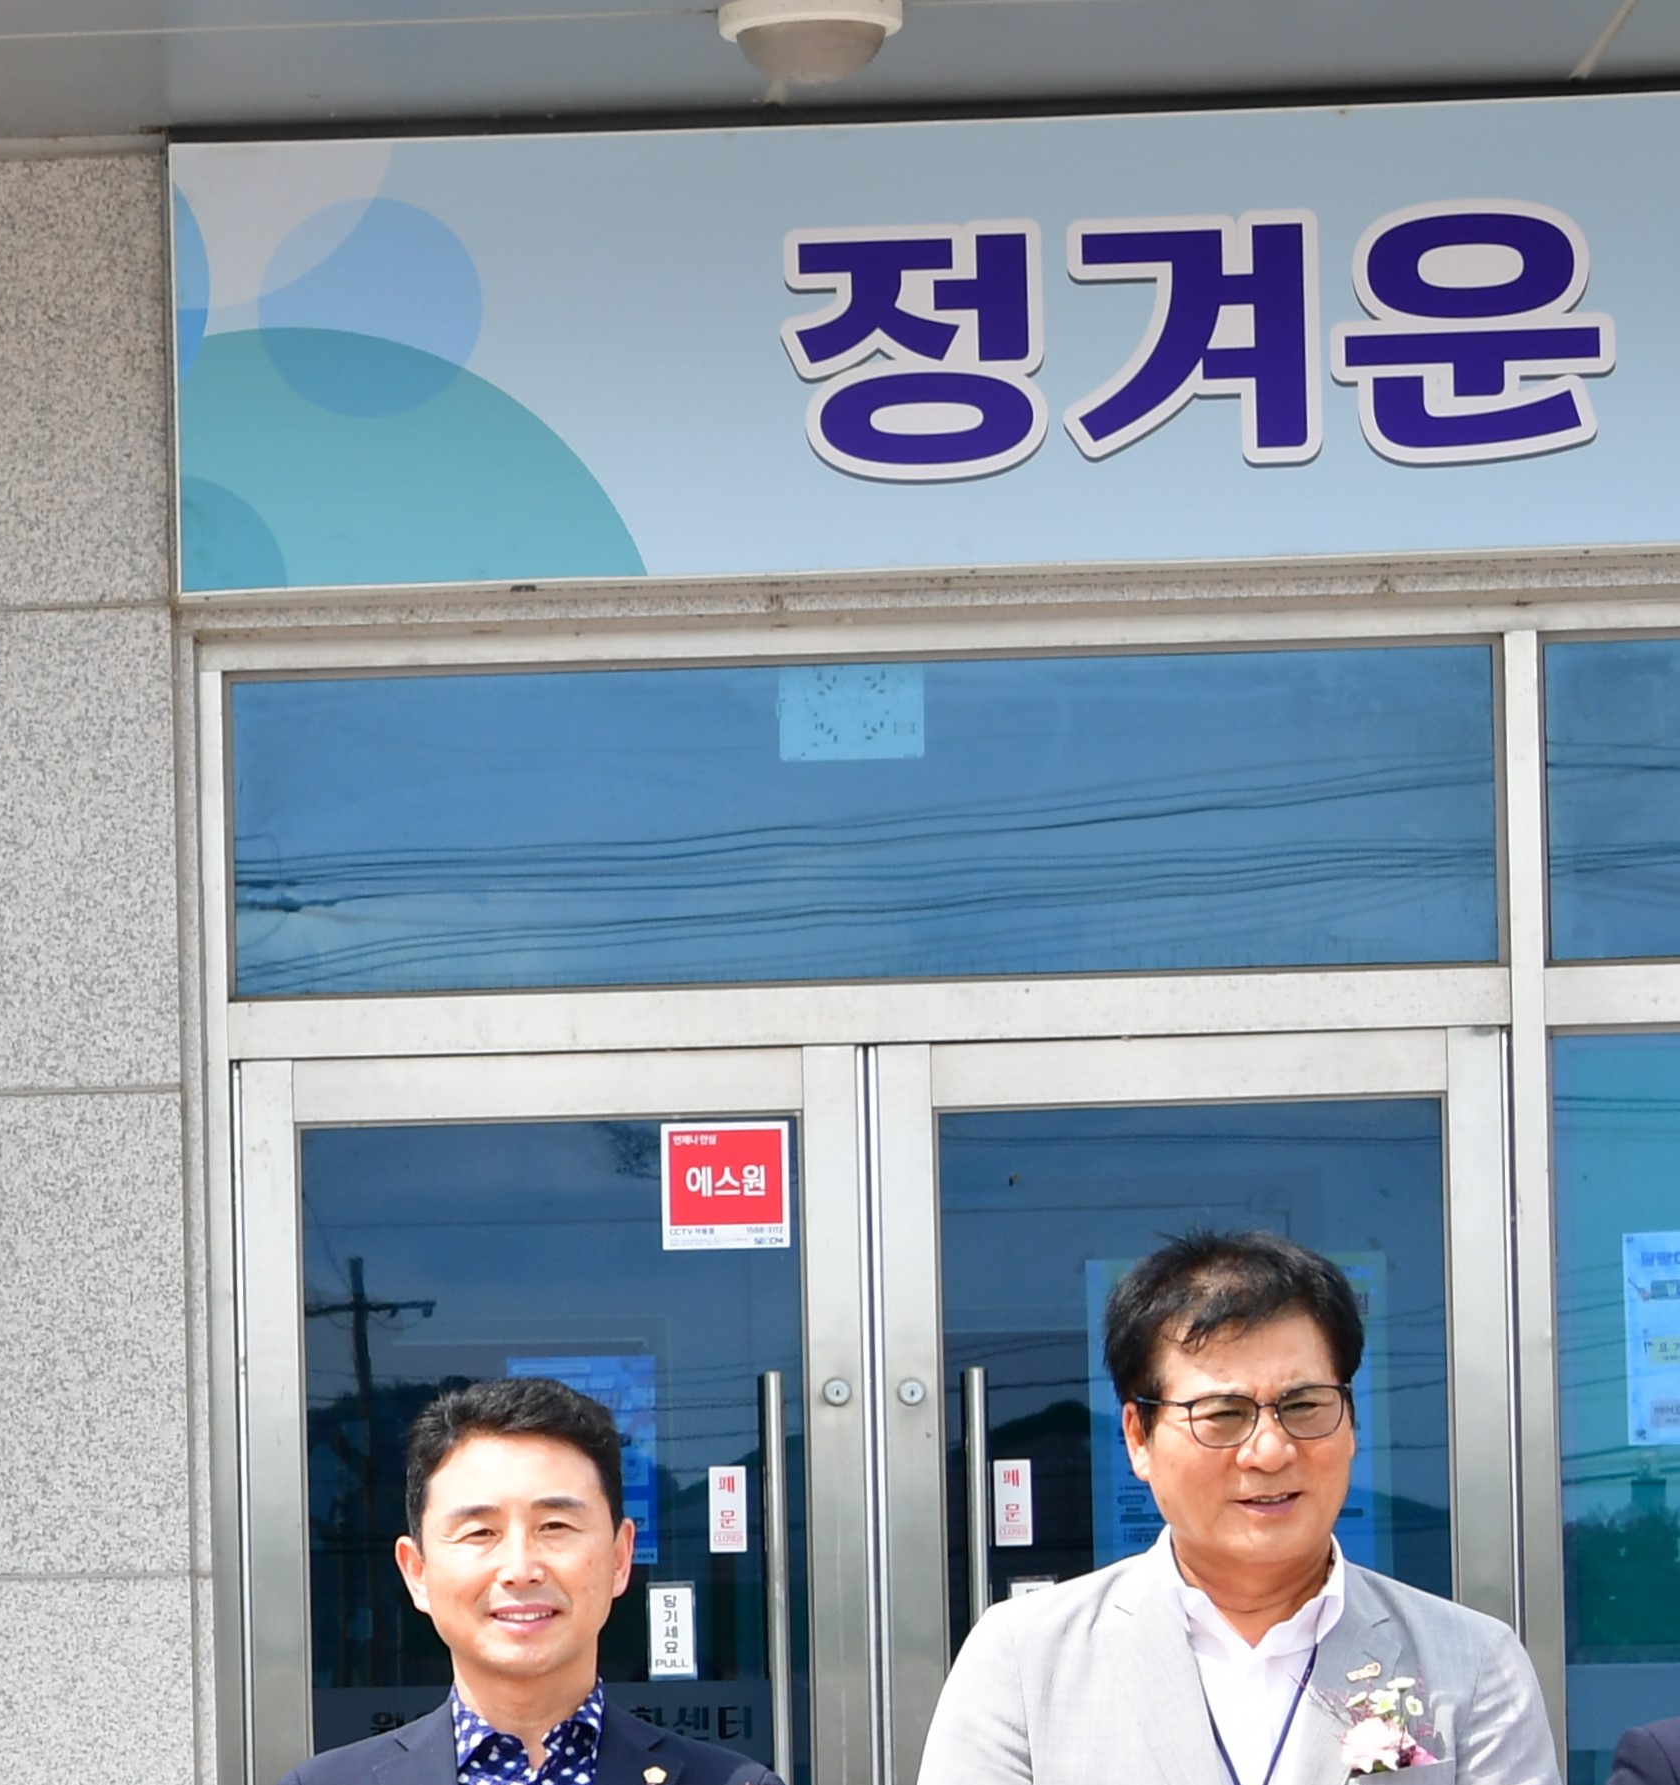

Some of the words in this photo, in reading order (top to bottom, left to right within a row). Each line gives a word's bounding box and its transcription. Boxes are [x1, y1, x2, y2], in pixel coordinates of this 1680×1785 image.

[783, 201, 1615, 480] 정겨운
[685, 1164, 766, 1197] 에스원
[670, 1228, 693, 1236] CCTV
[663, 1594, 678, 1654] 당기세요
[655, 1658, 689, 1668] PULL
